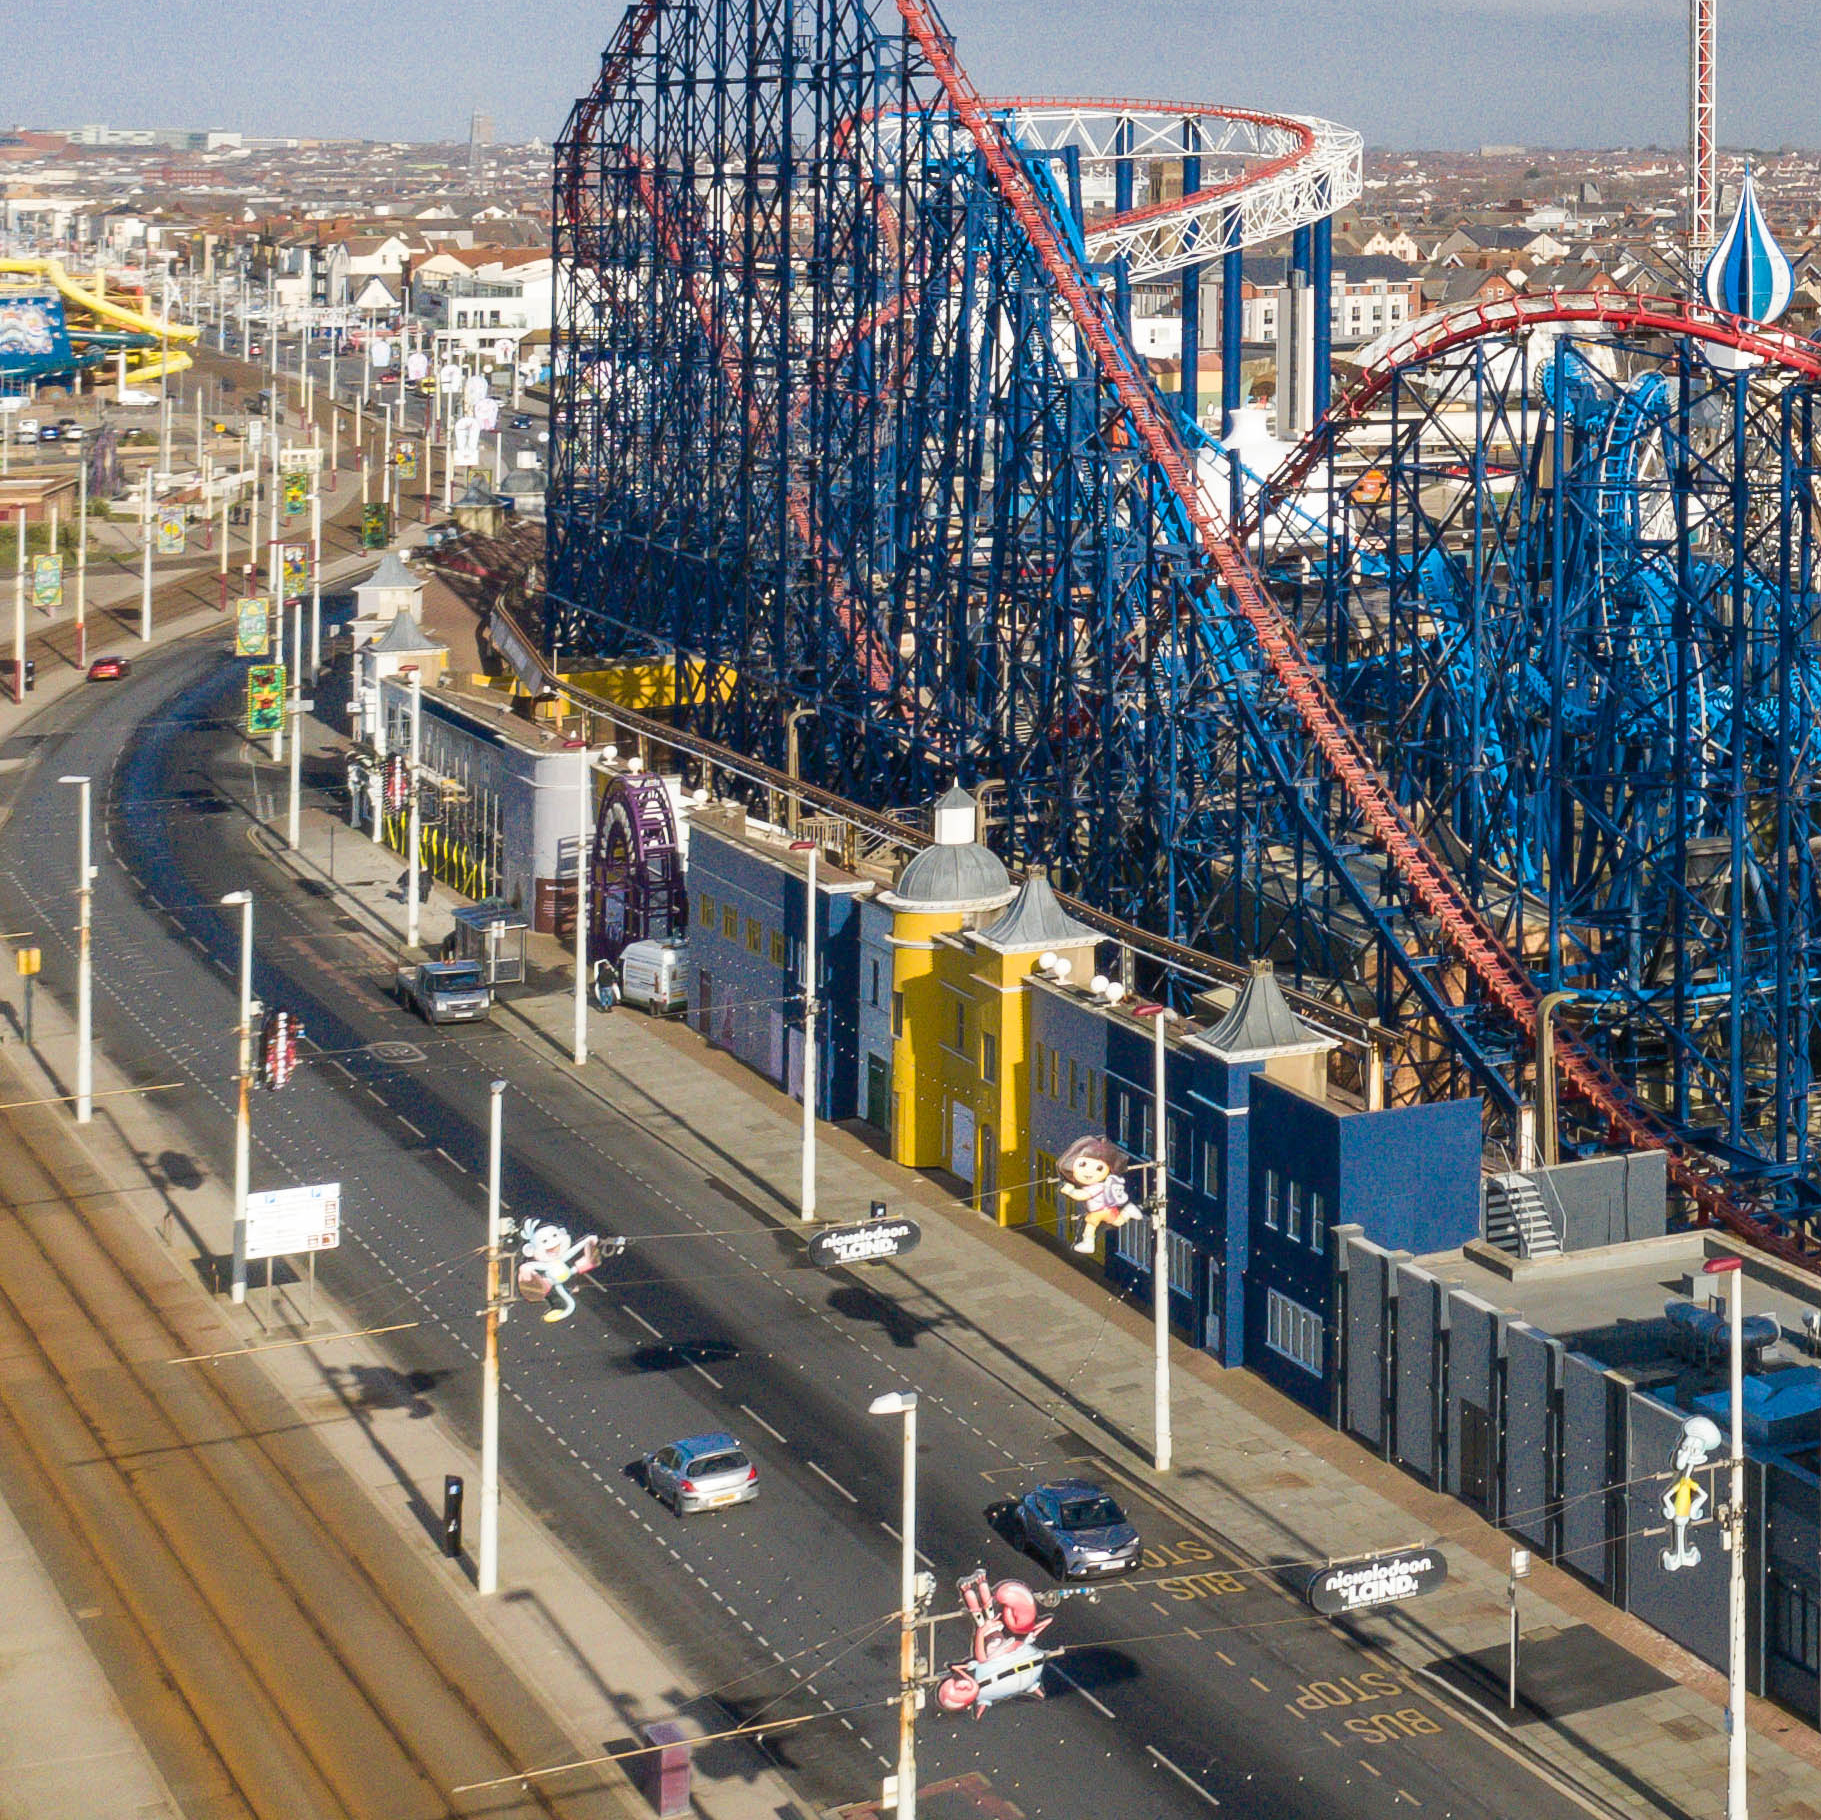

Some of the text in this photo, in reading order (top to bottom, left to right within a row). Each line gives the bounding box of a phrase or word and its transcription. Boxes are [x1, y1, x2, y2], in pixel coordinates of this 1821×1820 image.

[821, 1225, 910, 1249] nickelodeon
[1156, 1570, 1249, 1602] BUS
[1325, 1557, 1433, 1592] nickelodeon
[1296, 1672, 1403, 1711] STOP
[1343, 1708, 1443, 1744] BUS
